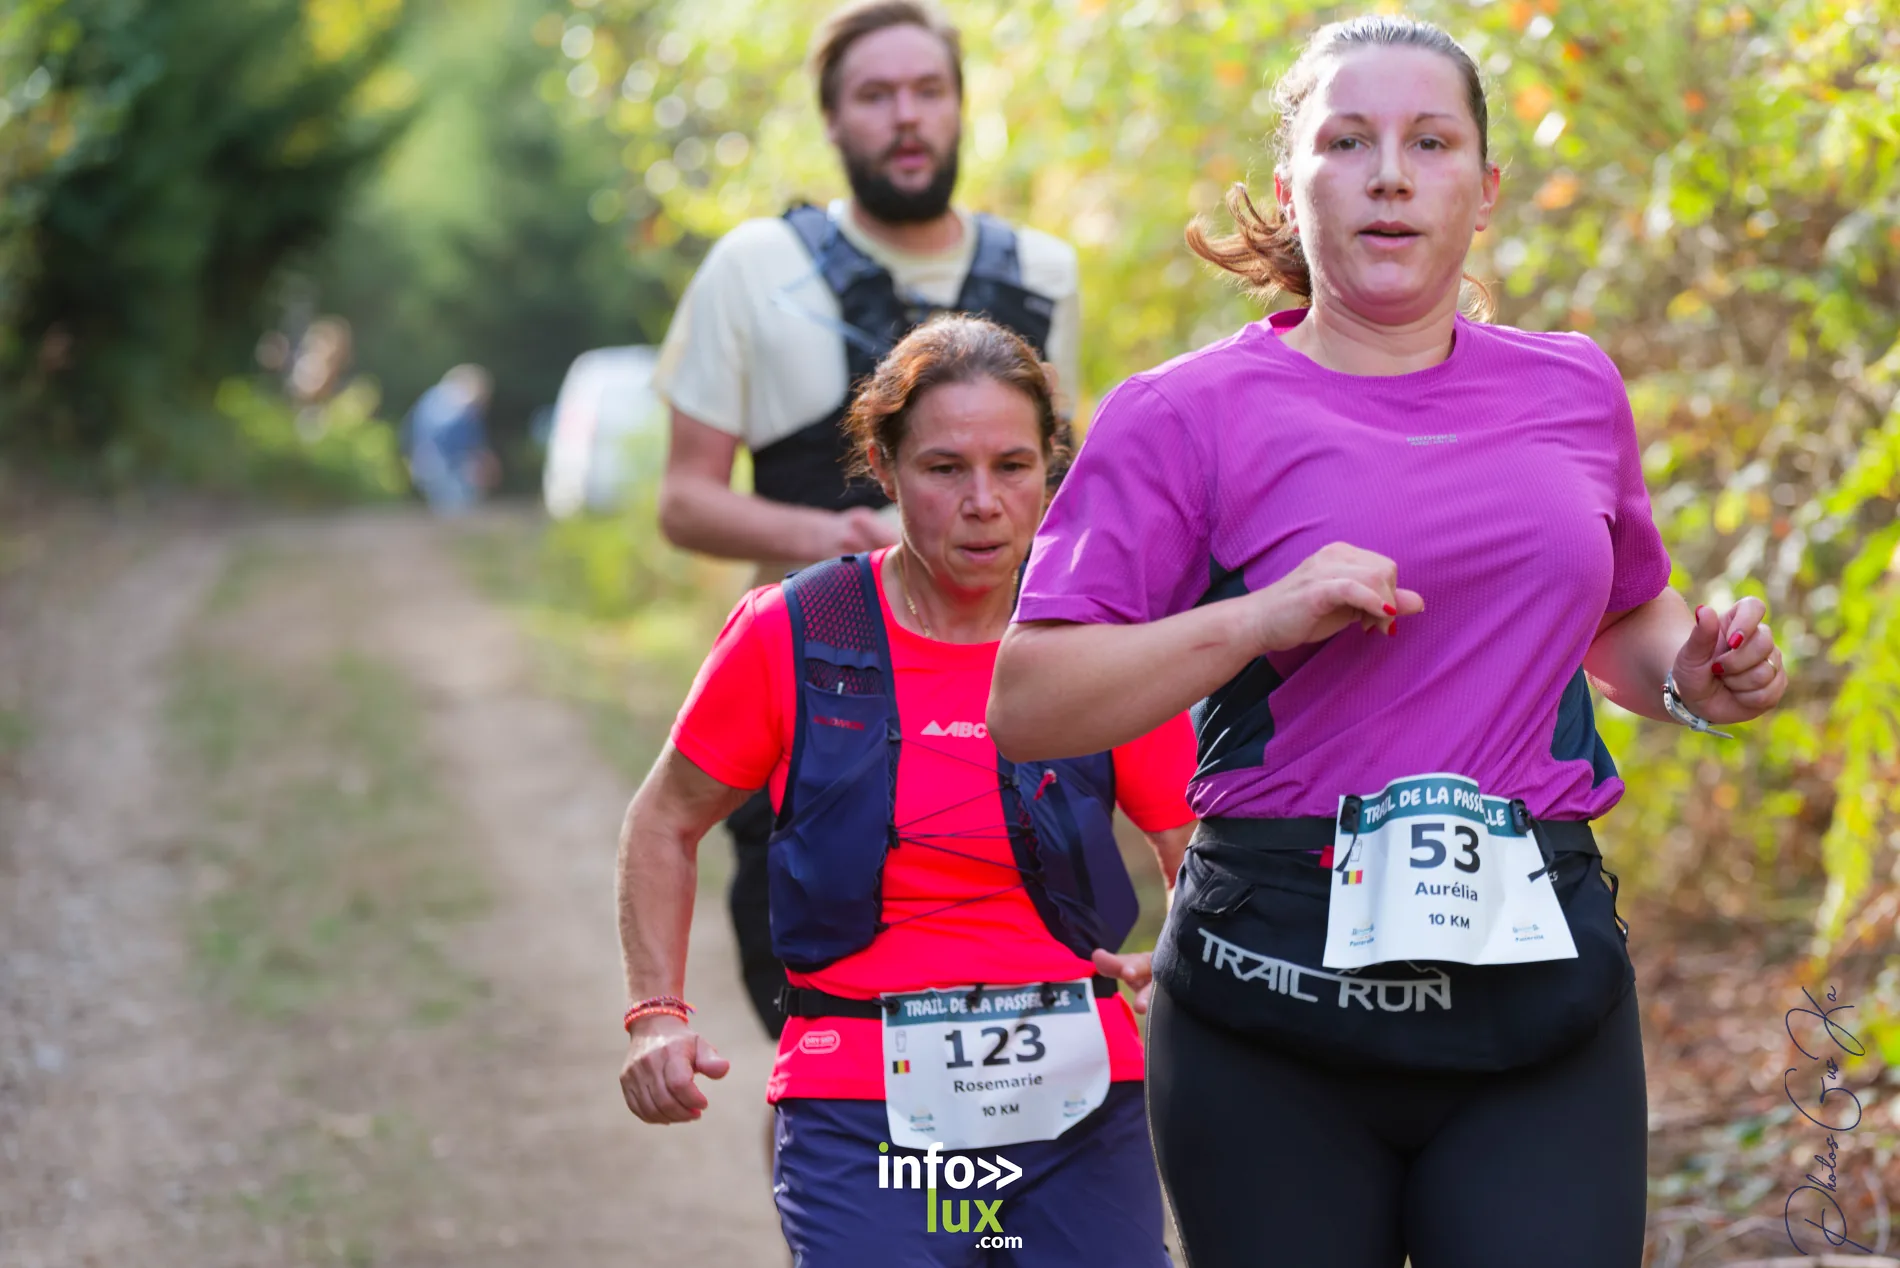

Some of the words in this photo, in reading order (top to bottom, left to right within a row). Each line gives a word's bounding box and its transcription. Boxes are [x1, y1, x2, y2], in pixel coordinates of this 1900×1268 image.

[1364, 795, 1396, 825] TRAIL
[1400, 787, 1421, 808] DE
[1425, 786, 1449, 805] LA
[1409, 822, 1481, 874] 53
[1415, 881, 1478, 902] Aurélia
[1428, 913, 1446, 926] 10
[1450, 914, 1470, 929] KM
[1198, 927, 1318, 1002] TRAIL
[1337, 974, 1452, 1011] RUN
[904, 998, 947, 1017] TRAIL
[951, 997, 968, 1014] DE
[944, 1023, 1047, 1070] 123
[953, 1074, 1043, 1093] Rosemarie
[982, 1106, 996, 1118] 10
[1000, 1103, 1020, 1116] KM
